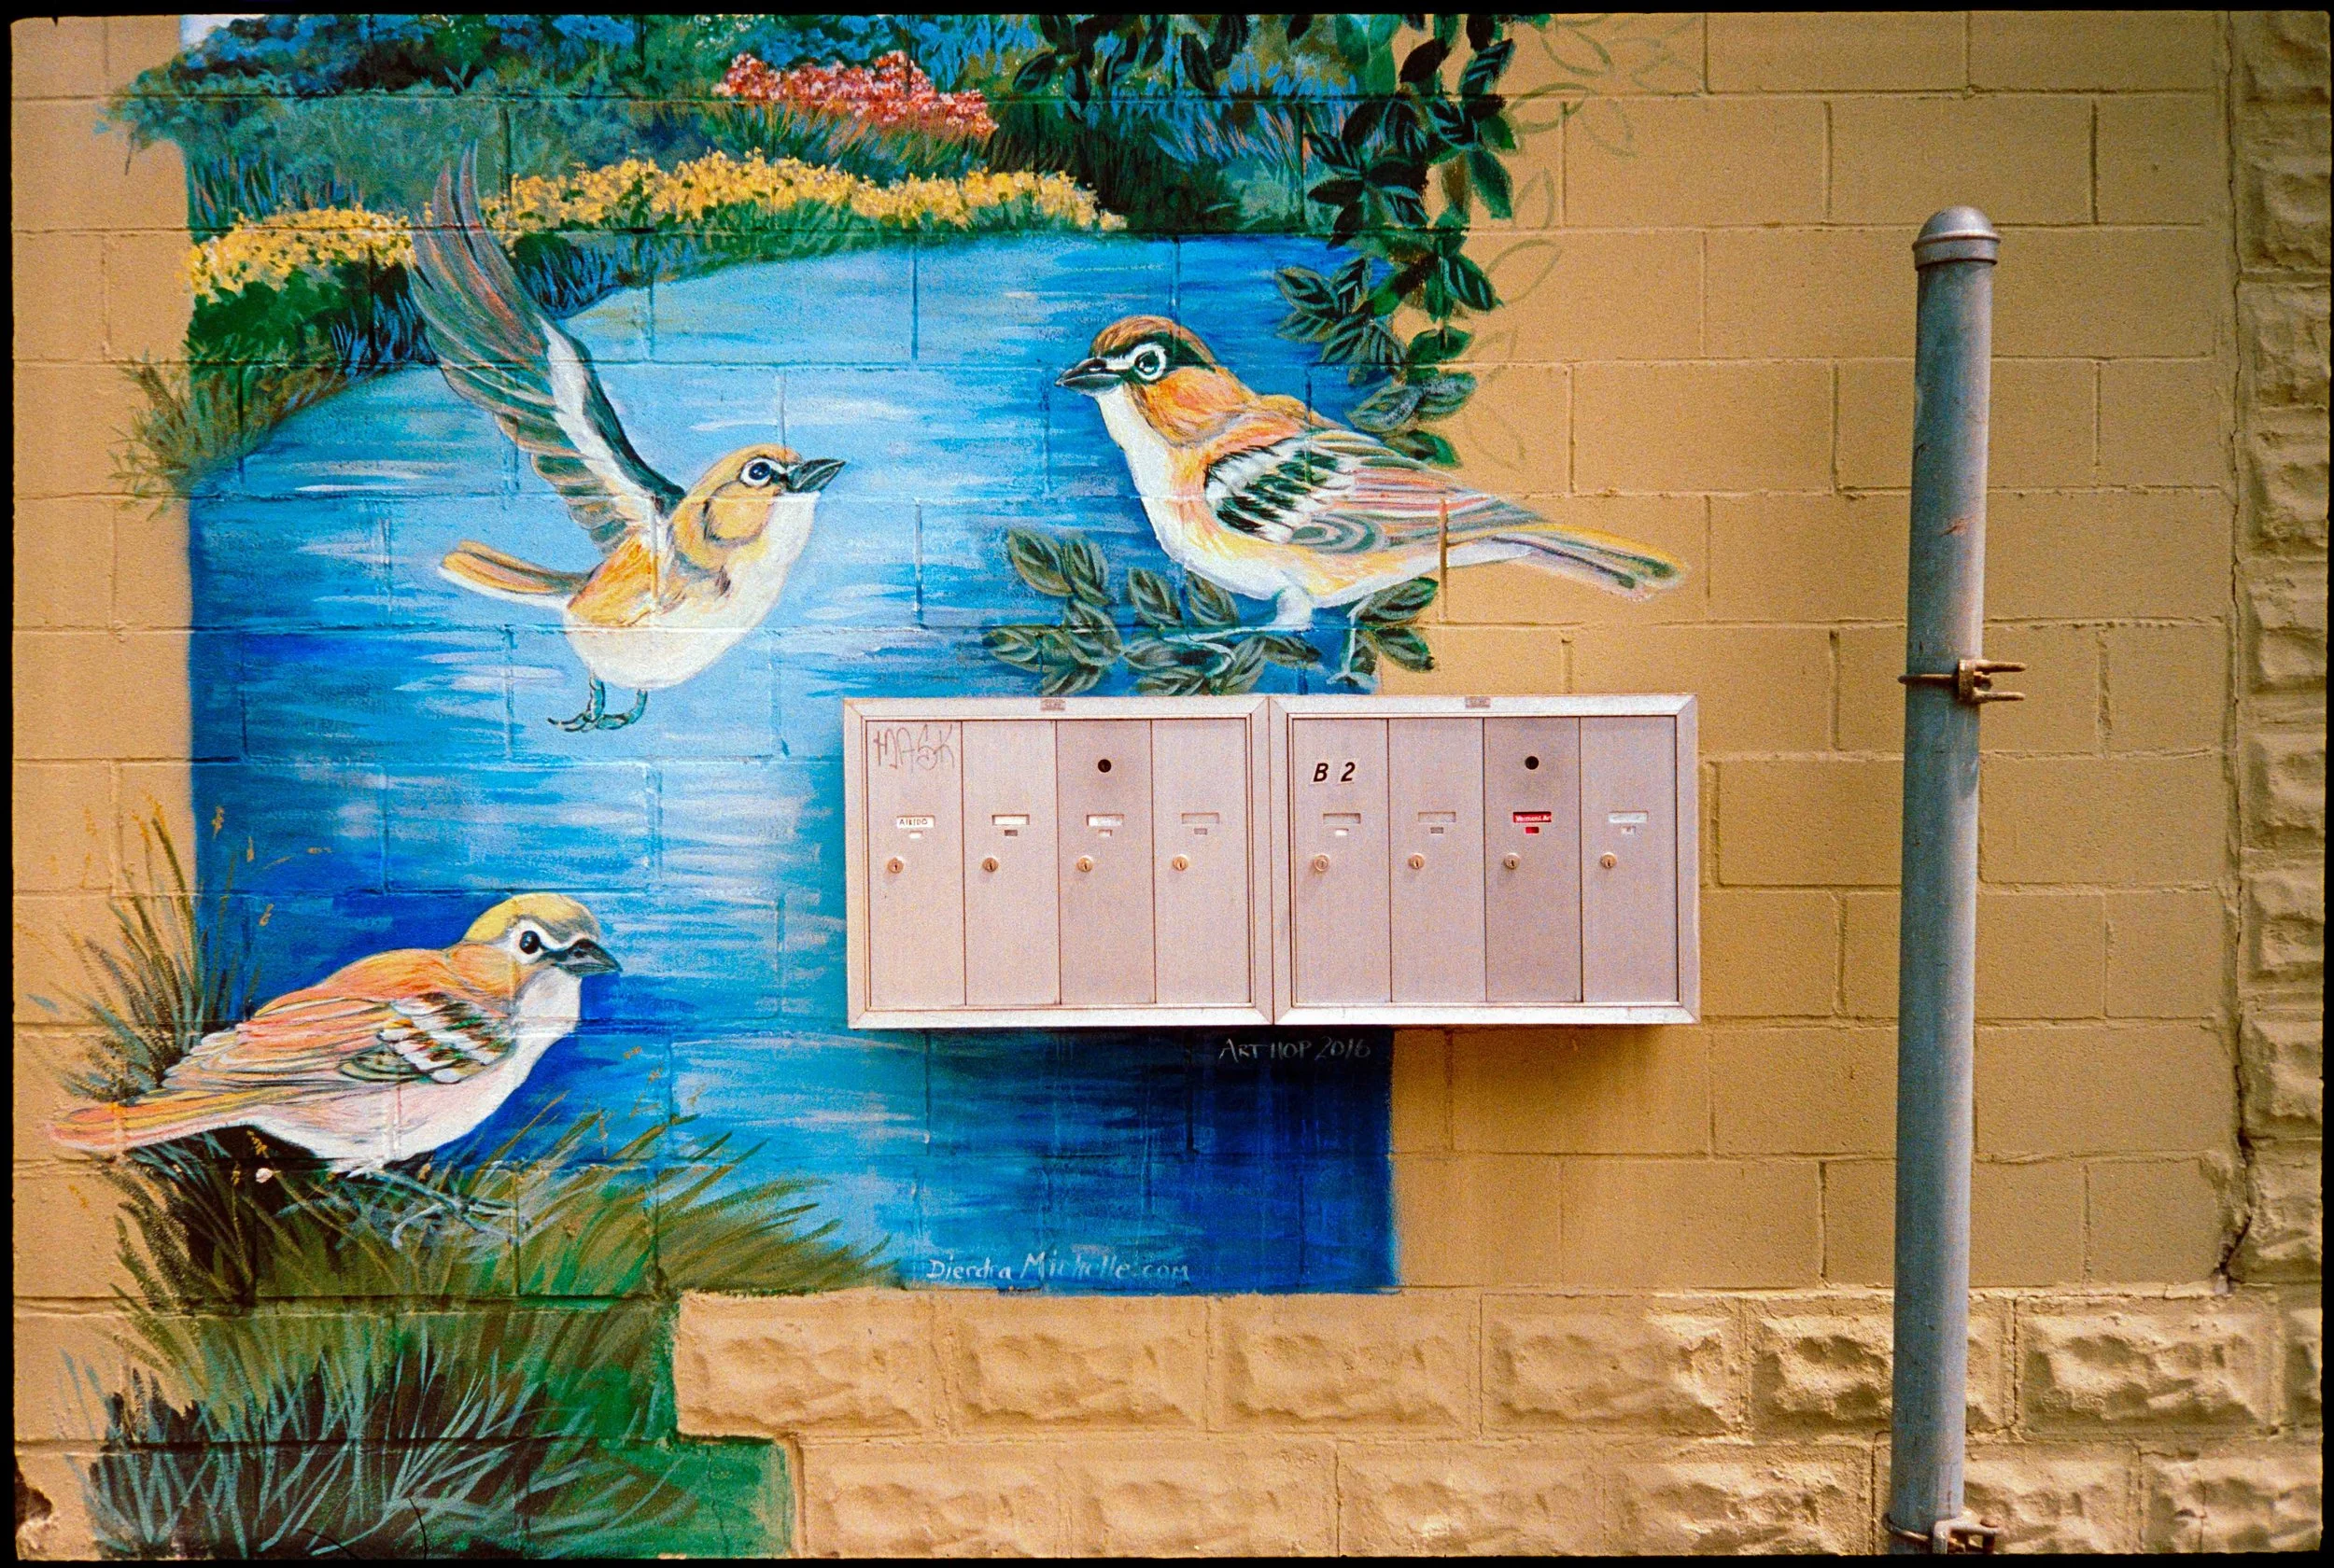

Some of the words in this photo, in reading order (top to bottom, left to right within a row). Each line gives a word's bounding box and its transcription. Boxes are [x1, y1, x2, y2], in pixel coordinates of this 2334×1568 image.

[1313, 762, 1329, 782] B
[1340, 761, 1356, 782] 2
[1315, 1036, 1371, 1061] 2016
